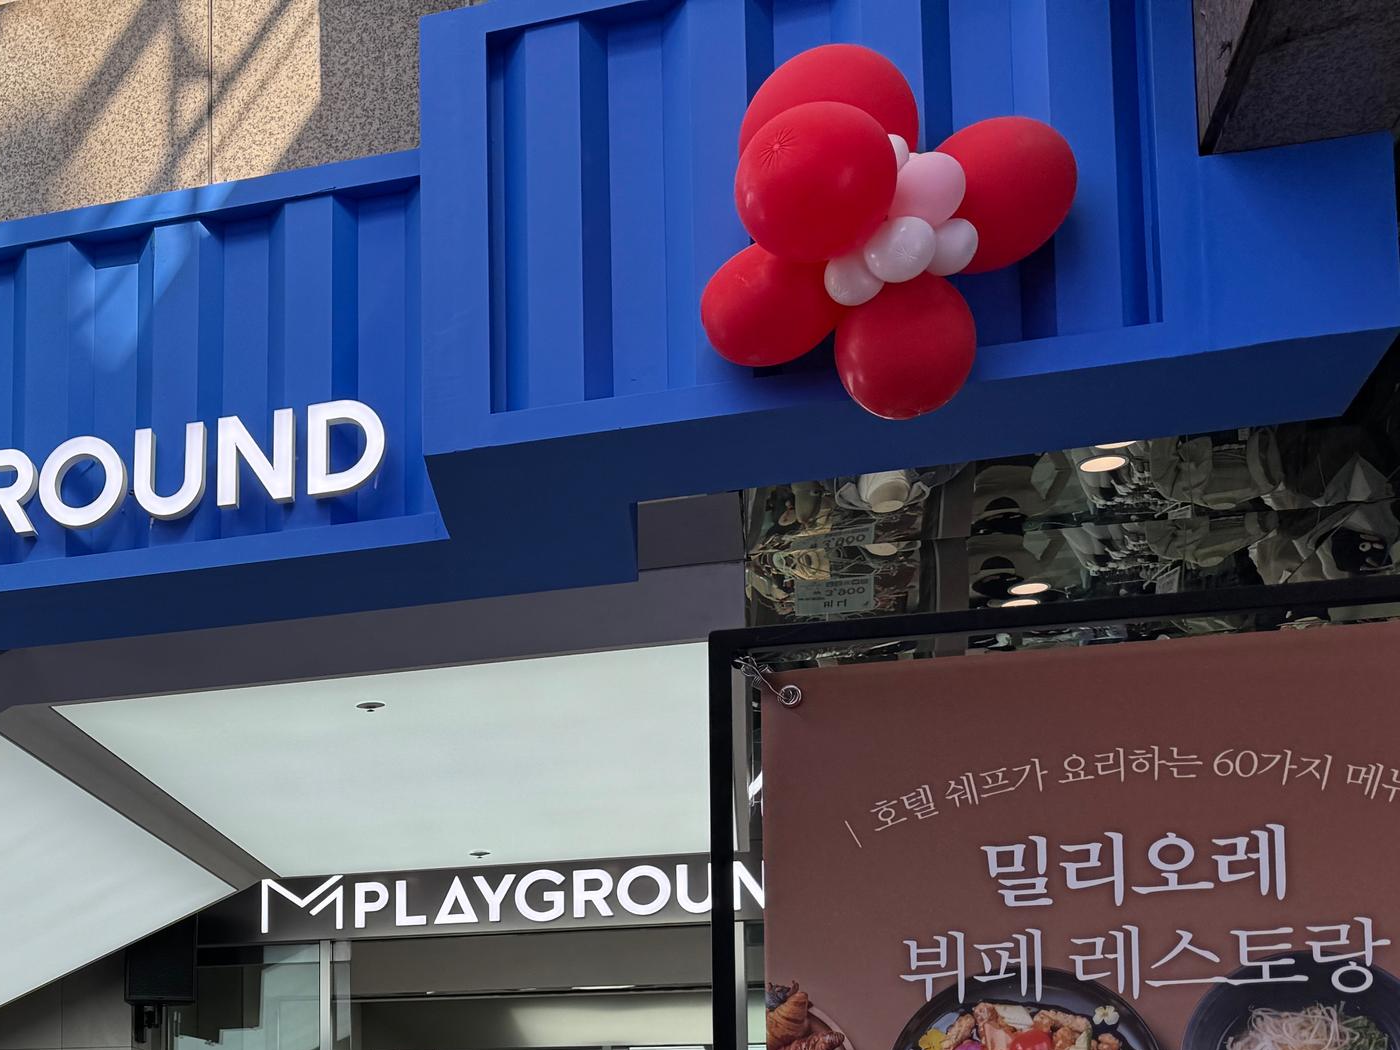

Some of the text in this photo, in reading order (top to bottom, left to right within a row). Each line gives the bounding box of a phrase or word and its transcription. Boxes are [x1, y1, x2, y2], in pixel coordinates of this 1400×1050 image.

[870, 784, 939, 832] 호텔
[945, 758, 1049, 809] 쉐프가
[1058, 745, 1203, 784] 요리하는
[1212, 749, 1332, 791] 60가지
[980, 822, 1286, 907] 밀리오레
[899, 916, 1392, 1004] 뷔페 레스토랑
